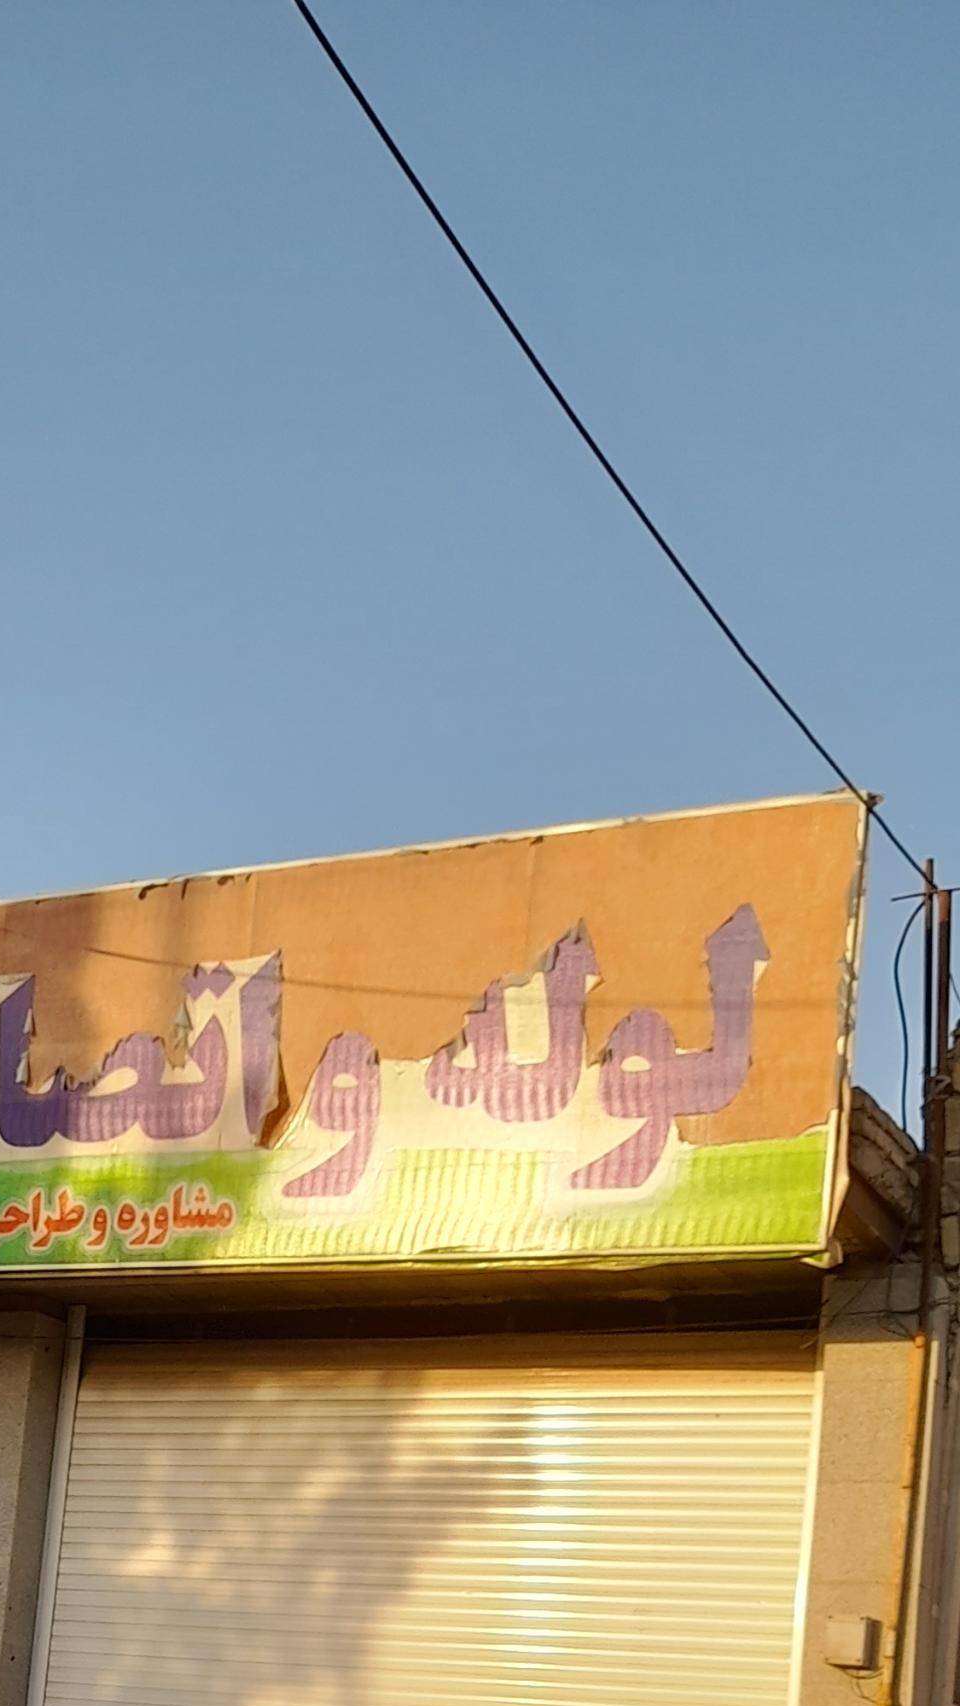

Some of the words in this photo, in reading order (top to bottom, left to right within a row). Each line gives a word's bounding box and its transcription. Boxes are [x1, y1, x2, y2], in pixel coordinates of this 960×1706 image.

[425, 902, 771, 1190] لوله
[281, 1030, 381, 1198] و
[86, 1207, 109, 1247] و
[116, 1184, 234, 1246] مشاوره
